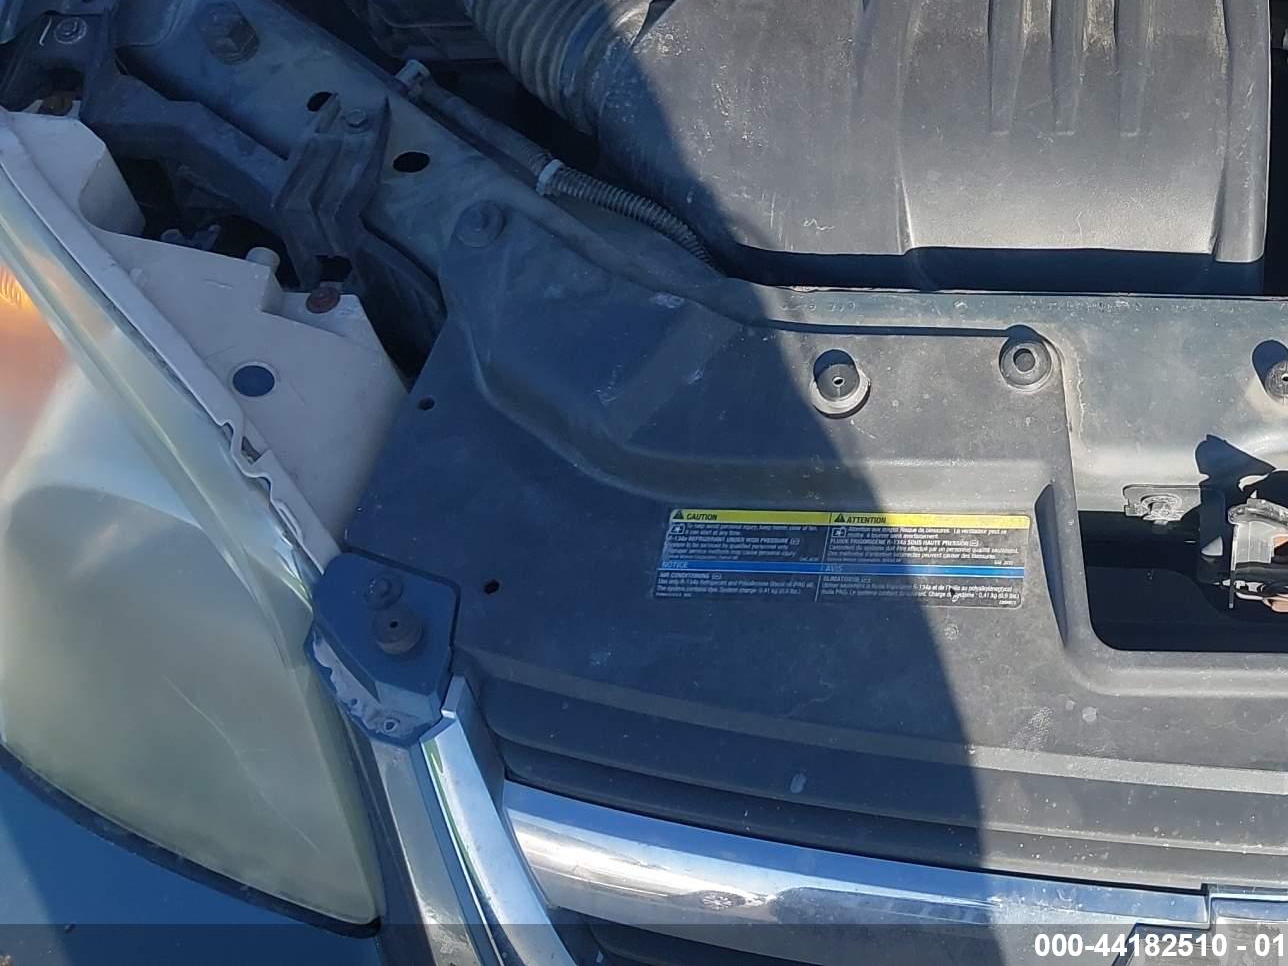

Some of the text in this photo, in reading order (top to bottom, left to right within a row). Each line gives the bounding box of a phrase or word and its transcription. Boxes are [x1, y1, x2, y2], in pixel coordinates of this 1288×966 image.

[686, 513, 718, 521] CAUTION
[846, 516, 887, 524] ATTENTION
[662, 561, 689, 569] NOTICE
